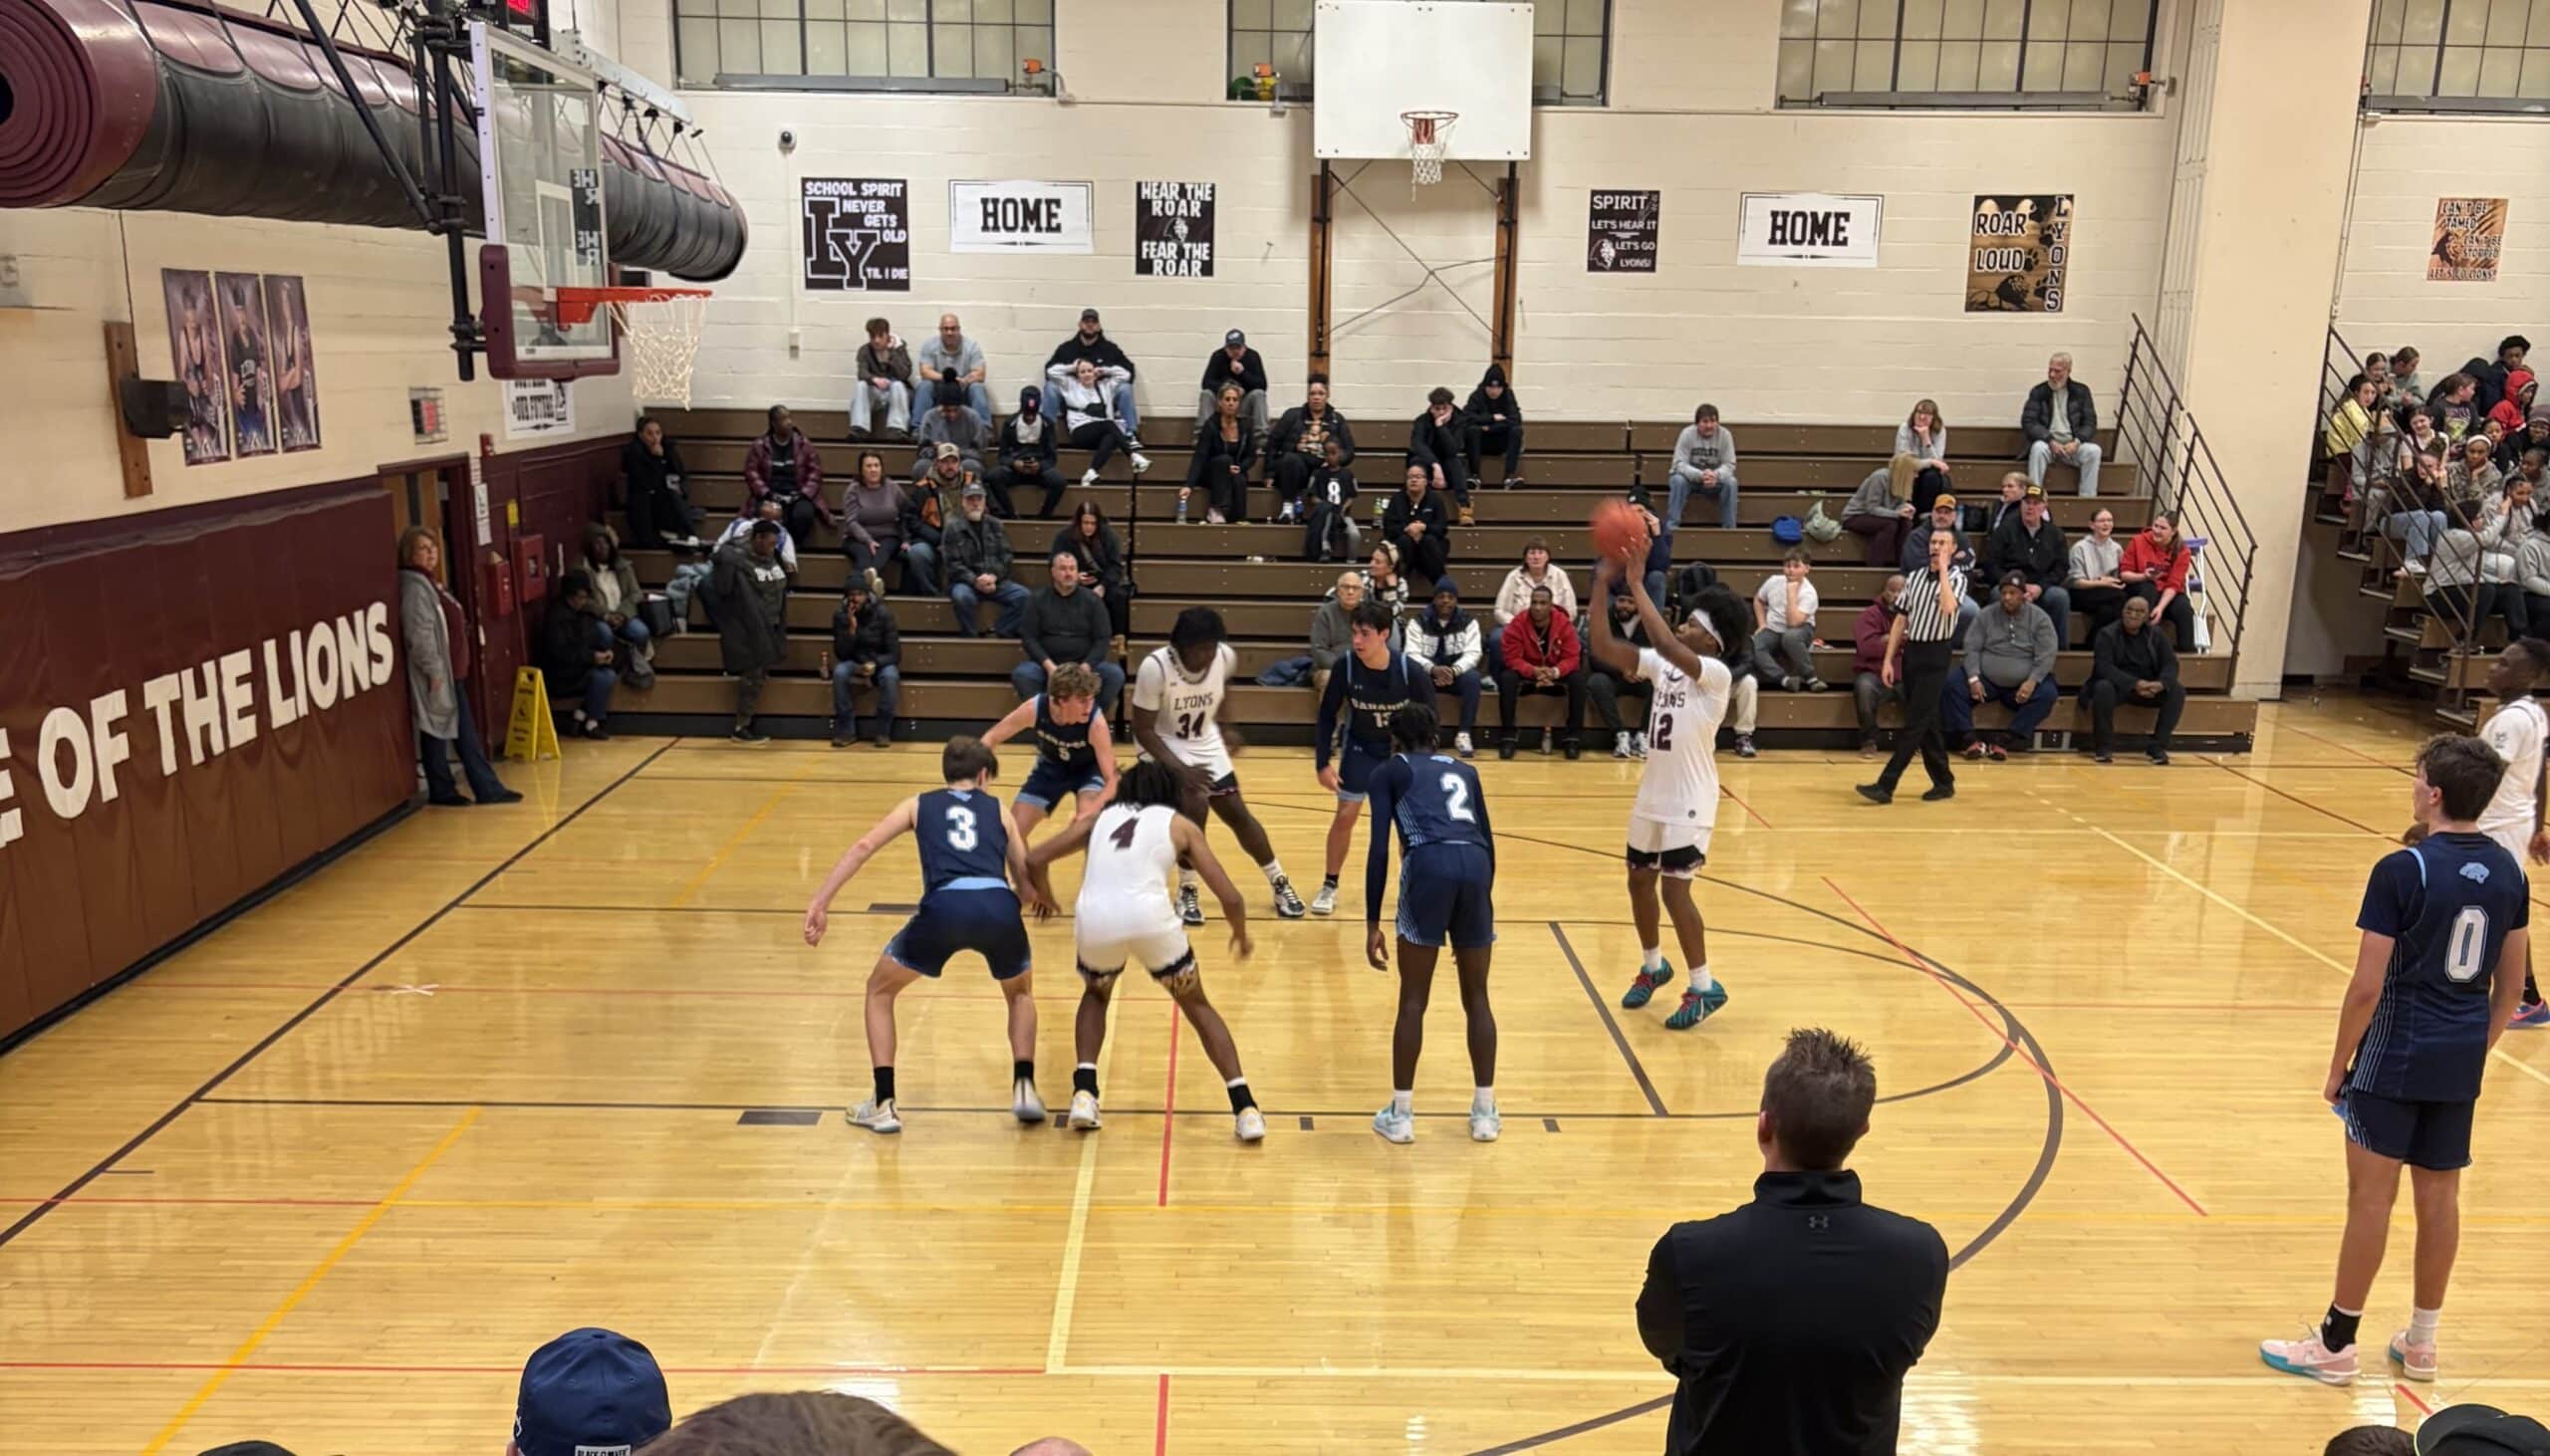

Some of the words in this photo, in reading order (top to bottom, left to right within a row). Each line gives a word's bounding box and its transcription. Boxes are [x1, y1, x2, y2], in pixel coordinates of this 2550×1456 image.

[805, 182, 857, 196] SCHOOL
[861, 183, 903, 197] SPIRIT
[1141, 182, 1179, 200] HEAR
[1185, 183, 1212, 201] THE
[842, 200, 887, 213] NEVER
[1151, 200, 1201, 217] ROAR
[1593, 195, 1649, 210] SPIRIT
[864, 214, 897, 227] GETS
[980, 197, 1062, 233] HOME
[1592, 220, 1618, 230] LET'S
[1619, 220, 1645, 230] HEAR
[1646, 220, 1658, 230] IT
[1974, 210, 2027, 236] ROAR
[882, 230, 907, 243] OLD
[1768, 210, 1851, 247] HOME
[1142, 241, 1178, 260] FEAR
[1182, 242, 1210, 261] THE
[1615, 241, 1640, 251] LET'S
[1641, 241, 1656, 251] GO
[2044, 195, 2070, 312] LYONS
[1152, 259, 1202, 277] ROAR
[1974, 247, 2025, 273] LOUD
[885, 267, 890, 279] I
[891, 268, 908, 280] DIE
[1327, 481, 1341, 505] 8
[38, 689, 129, 820] OF
[143, 647, 258, 777] THE
[263, 601, 393, 731] LIONS
[1174, 692, 1213, 710] LYONS
[1175, 712, 1206, 740] 34
[1650, 712, 1673, 752] 12
[1438, 772, 1476, 824] 2
[945, 806, 978, 851] 3
[1109, 817, 1141, 850] 4
[2445, 905, 2489, 983] 0
